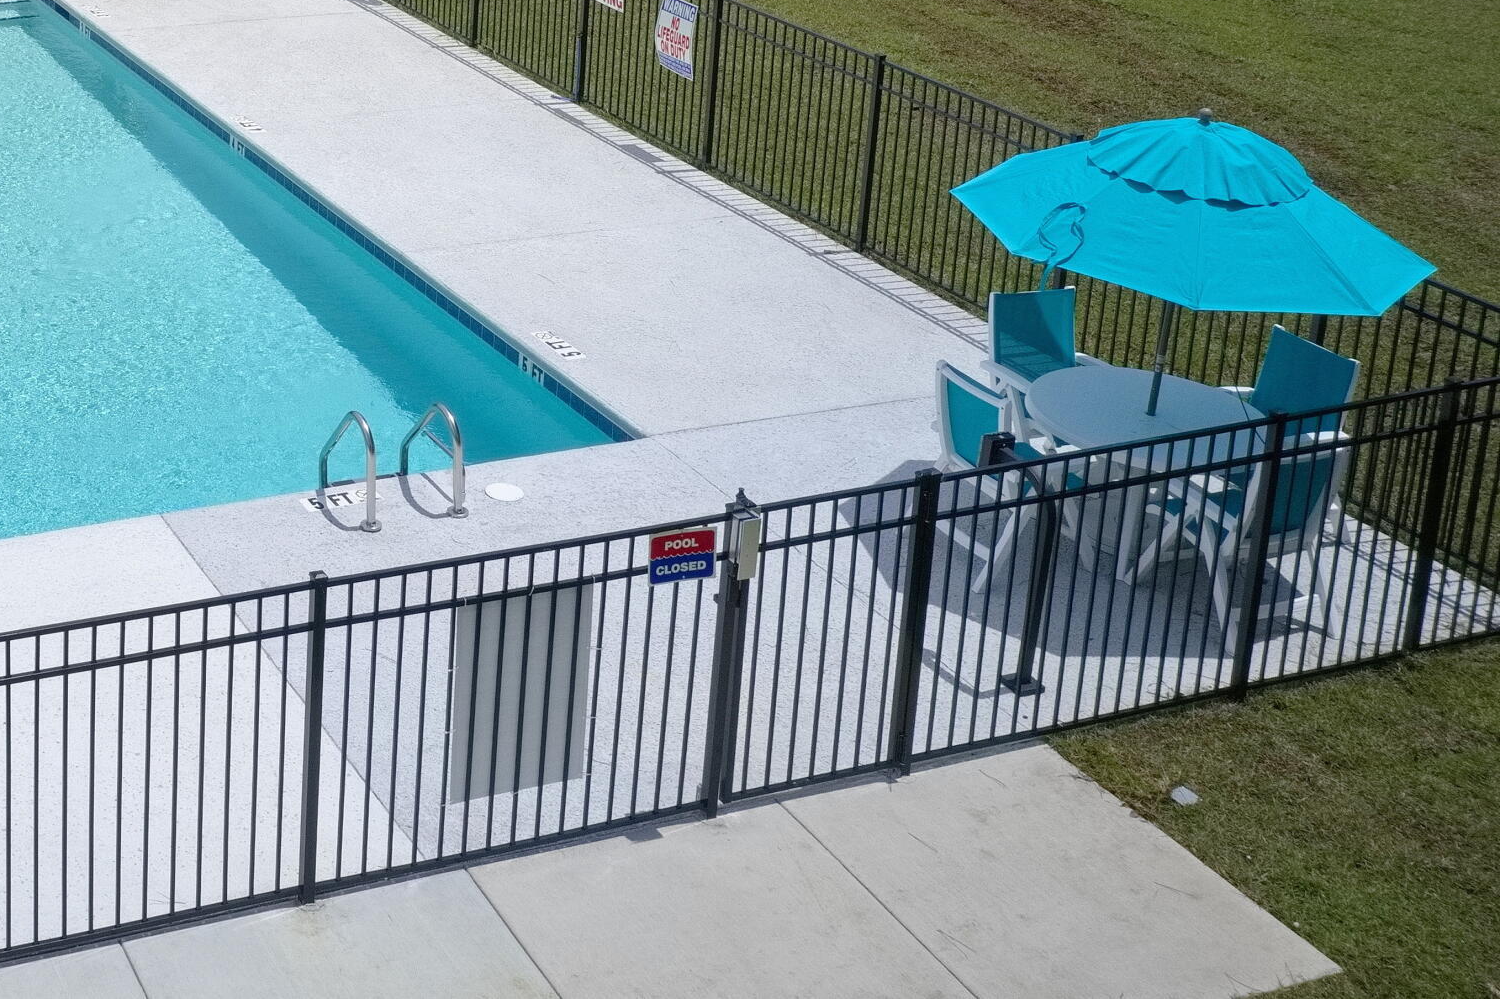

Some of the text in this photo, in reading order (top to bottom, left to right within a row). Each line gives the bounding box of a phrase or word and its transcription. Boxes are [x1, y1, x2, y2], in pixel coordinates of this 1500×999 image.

[671, 16, 680, 31] NO
[657, 24, 690, 50] LIFEGUARD
[660, 40, 686, 60] ON DUTY
[545, 340, 572, 350] FT
[532, 362, 543, 383] FT
[307, 497, 325, 510] 5
[326, 492, 353, 507] FT
[664, 537, 699, 551] POOL
[655, 560, 707, 576] CLOSED
